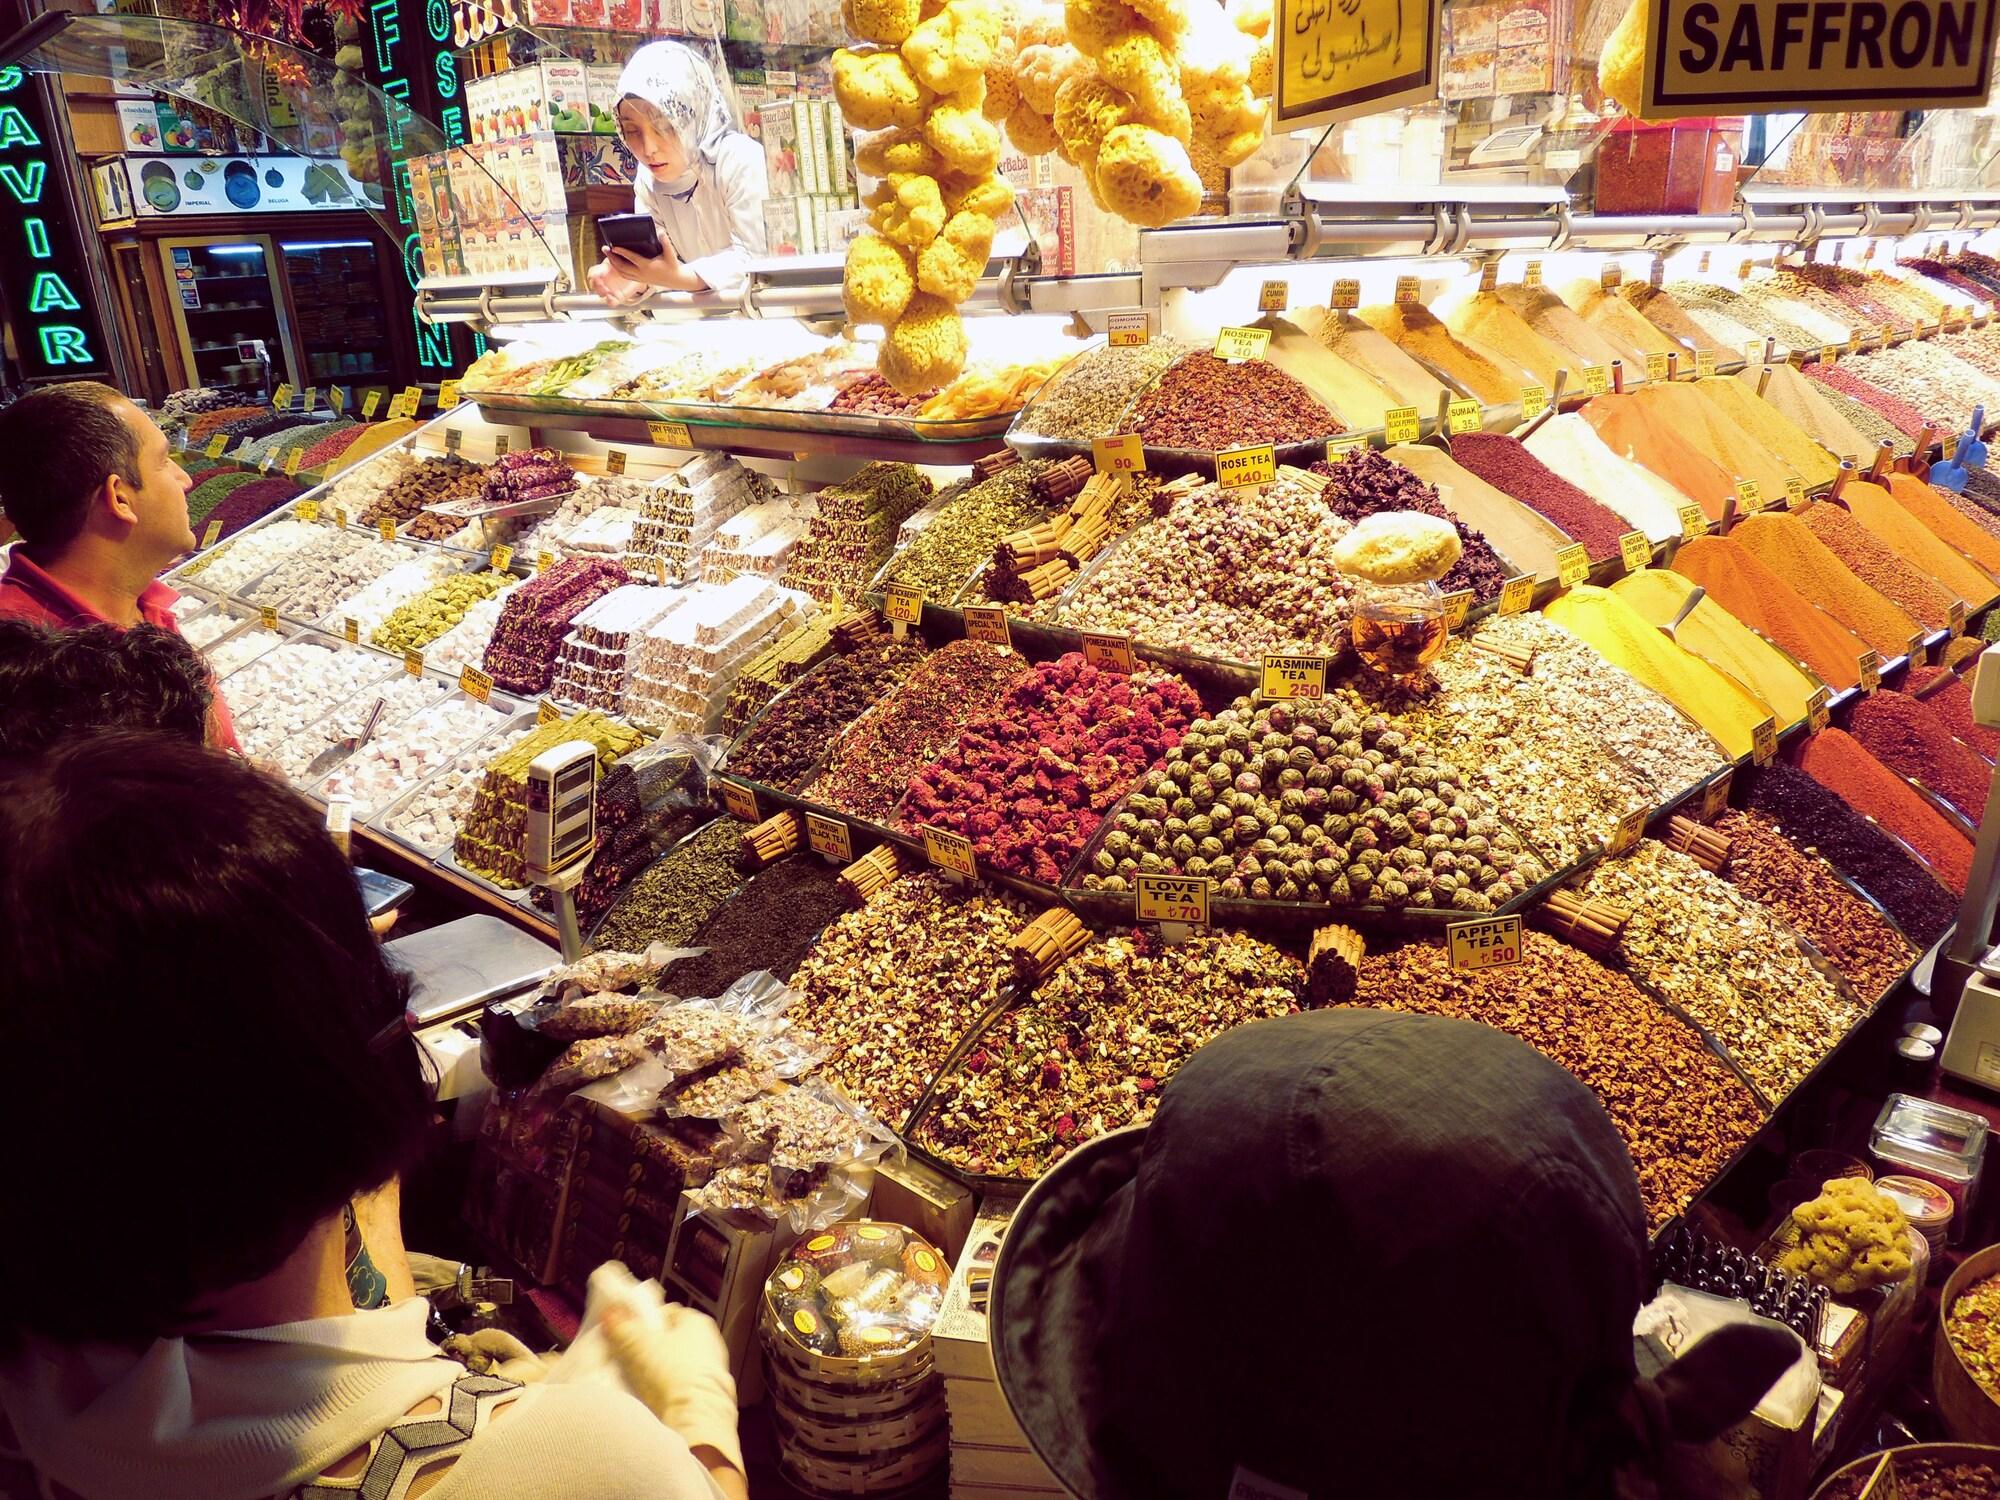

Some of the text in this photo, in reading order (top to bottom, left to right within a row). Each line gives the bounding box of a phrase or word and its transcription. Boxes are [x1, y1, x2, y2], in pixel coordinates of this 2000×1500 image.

[1679, 1, 1976, 74] SAFFRON
[1061, 190, 1073, 272] HazerBaba
[1266, 289, 1284, 297] CUMIN
[1124, 333, 1138, 344] 70
[1224, 330, 1265, 340] ROSEHIP
[1233, 338, 1252, 346] TEA
[1451, 405, 1477, 417] SUMAK
[1462, 419, 1473, 429] 35
[1114, 457, 1132, 469] 90
[1221, 454, 1271, 471] ROSE TEA
[1235, 471, 1262, 484] 140
[1624, 535, 1644, 547] INDIAN
[1625, 544, 1646, 555] CURRY
[1507, 576, 1536, 593] LEMON
[888, 587, 920, 599] BLACKBERRY
[1511, 588, 1526, 599] TEA
[895, 597, 910, 608] TEA
[894, 606, 910, 620] 120
[972, 611, 995, 621] TURKISH
[968, 619, 1003, 630] SPECIAL TEA
[979, 629, 996, 642] 120
[1085, 636, 1126, 650] POMEGRANATE
[1100, 648, 1114, 658] TEA
[1096, 657, 1120, 671] 220
[1266, 659, 1322, 671] JASMINE
[1280, 670, 1307, 680] TEA
[462, 673, 489, 691] LOKUM
[1290, 683, 1320, 697] 250
[814, 820, 840, 834] TURKISH
[810, 827, 845, 845] BLACK TEA
[926, 830, 967, 852] LEMON
[824, 842, 839, 854] 40
[935, 841, 961, 858] TEA
[1144, 880, 1200, 893] LOVE
[1149, 891, 1195, 904] TEA
[1178, 906, 1201, 920] 70
[1456, 921, 1515, 940] APPLE
[1466, 935, 1505, 949] TEA
[1492, 947, 1515, 963] 50
